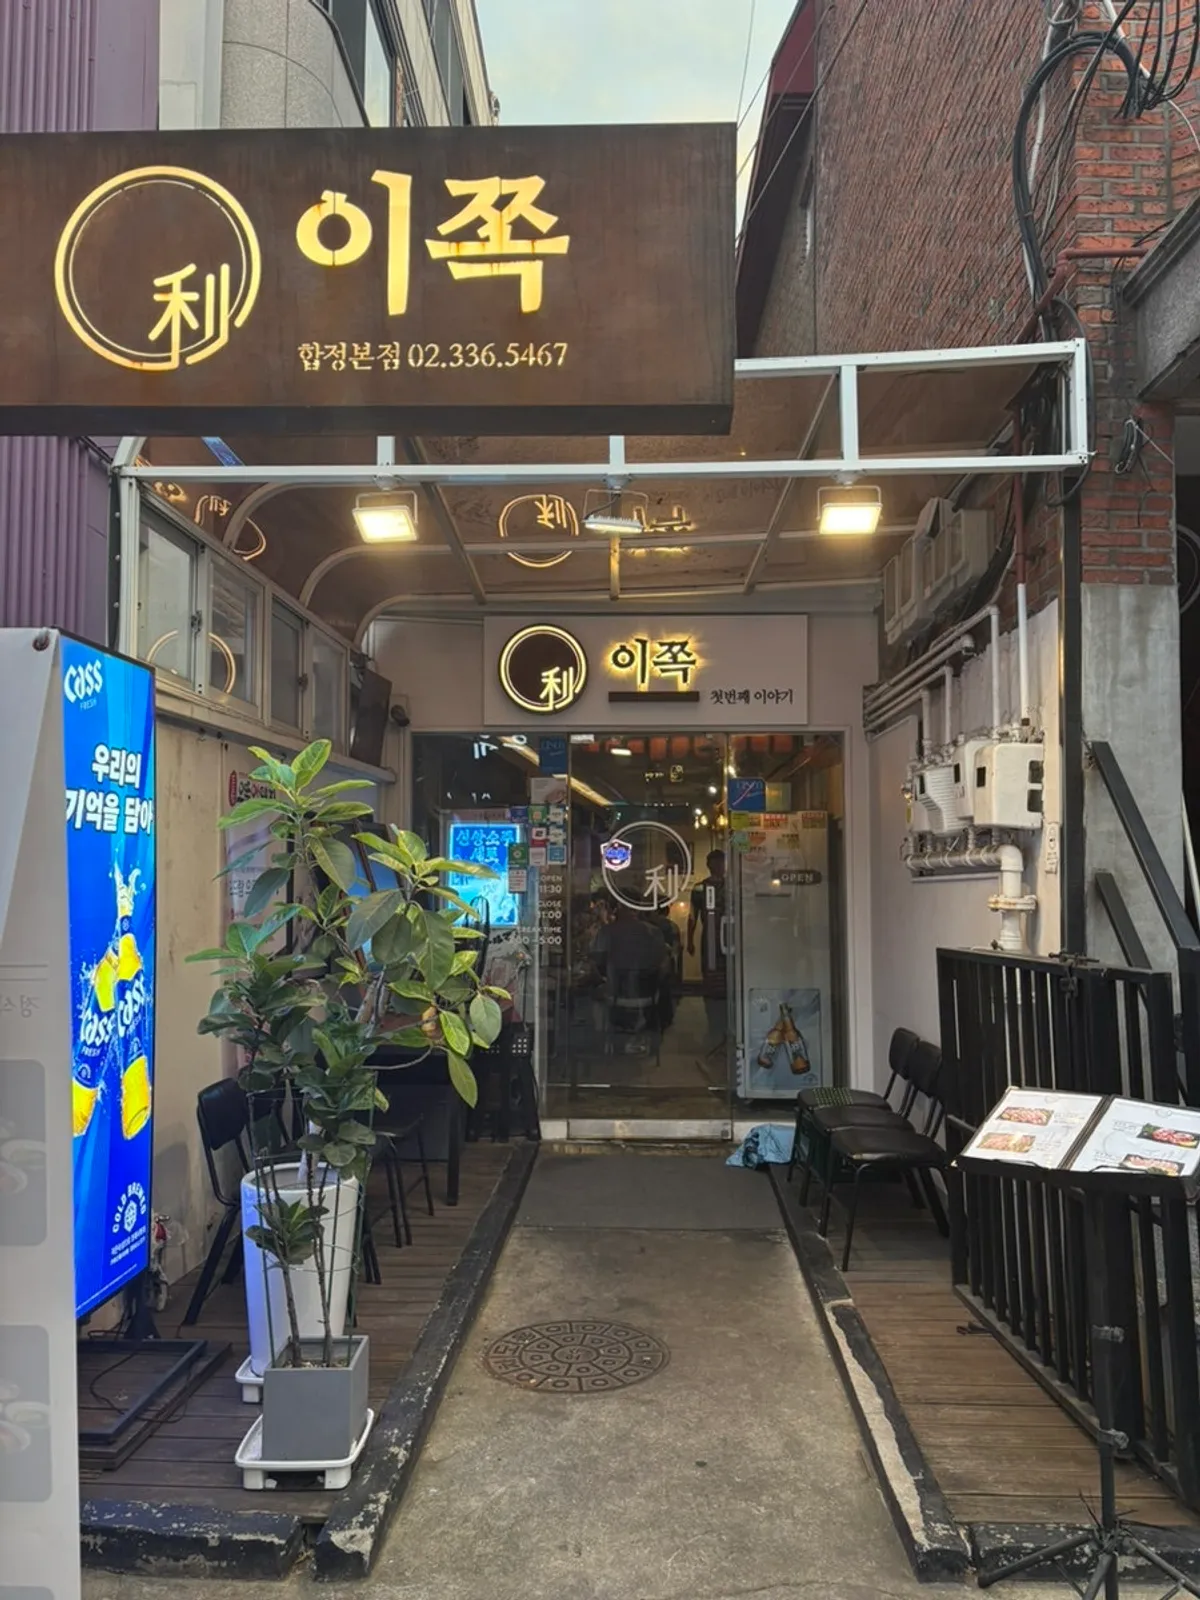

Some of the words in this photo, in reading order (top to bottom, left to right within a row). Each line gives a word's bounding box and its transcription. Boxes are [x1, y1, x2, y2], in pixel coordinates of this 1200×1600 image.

[296, 169, 570, 315] 이쪽
[297, 341, 401, 371] 합정본점
[407, 341, 569, 369] 02.336.5467
[610, 638, 696, 685] 이쪽
[753, 688, 794, 705] 이야기
[92, 744, 142, 788] 우리의
[65, 788, 120, 832] 기억을
[781, 873, 814, 883] OPEN
